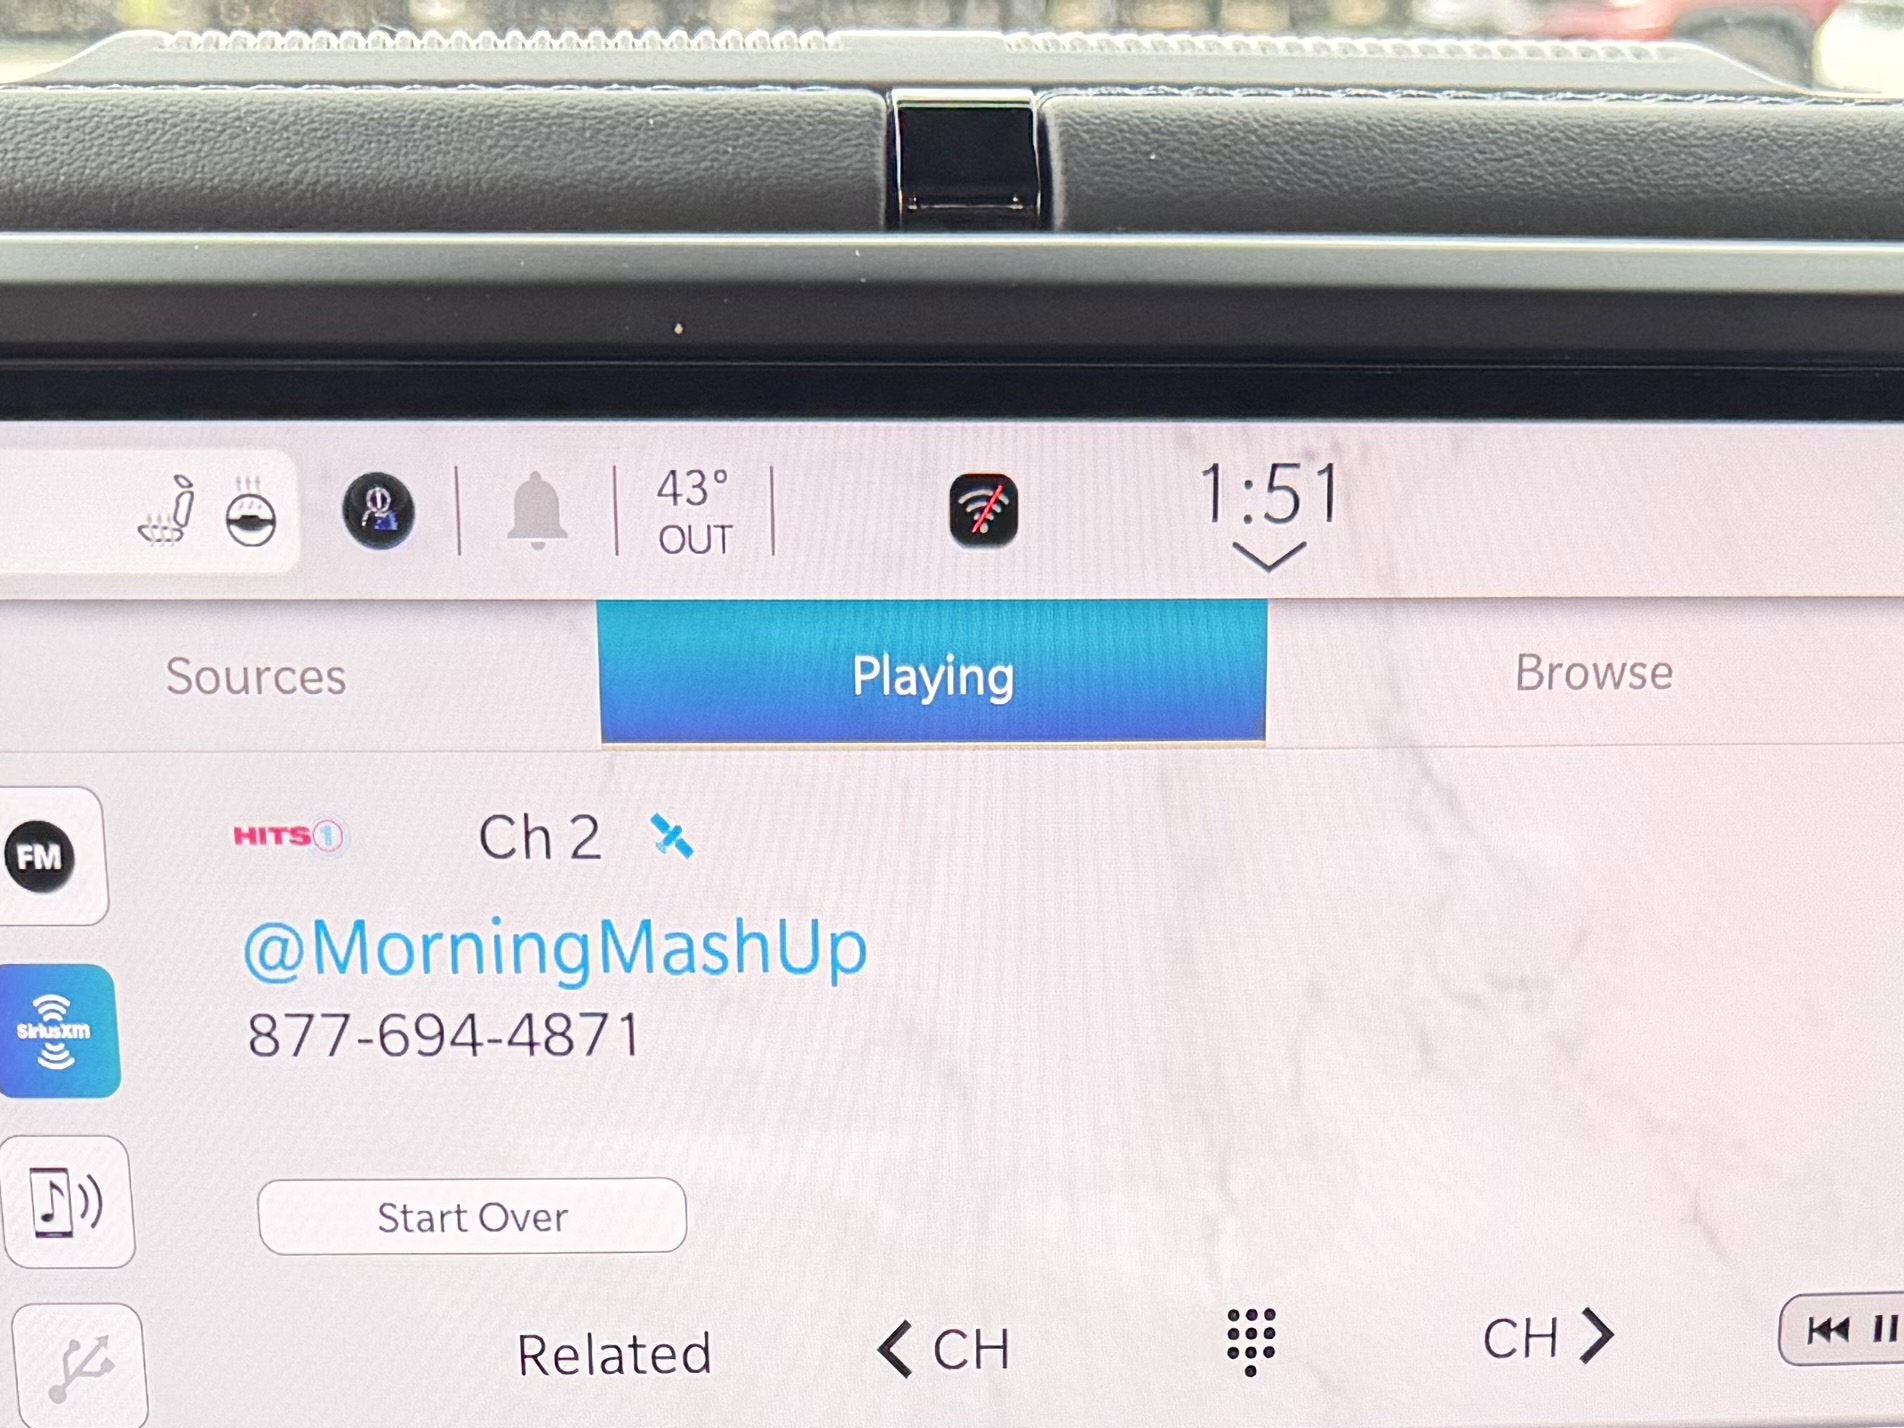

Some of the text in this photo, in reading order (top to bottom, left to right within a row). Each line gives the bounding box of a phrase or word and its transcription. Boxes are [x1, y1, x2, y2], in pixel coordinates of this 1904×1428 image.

[656, 468, 729, 507] 43°
[1201, 461, 1340, 525] 1:51
[658, 524, 733, 556] OUT
[166, 655, 346, 697] Sources
[852, 653, 1015, 705] Playing
[1516, 652, 1674, 692] Browse
[234, 826, 311, 846] HITS
[479, 813, 602, 860] Ch 2
[16, 844, 60, 871] FM
[244, 917, 868, 989] @MorningMashUp
[248, 1011, 640, 1059] 877-694-4871
[378, 1201, 568, 1234] Start Over
[518, 1331, 711, 1376] Related
[934, 1328, 1009, 1370] CH
[1485, 1316, 1558, 1360] CH
